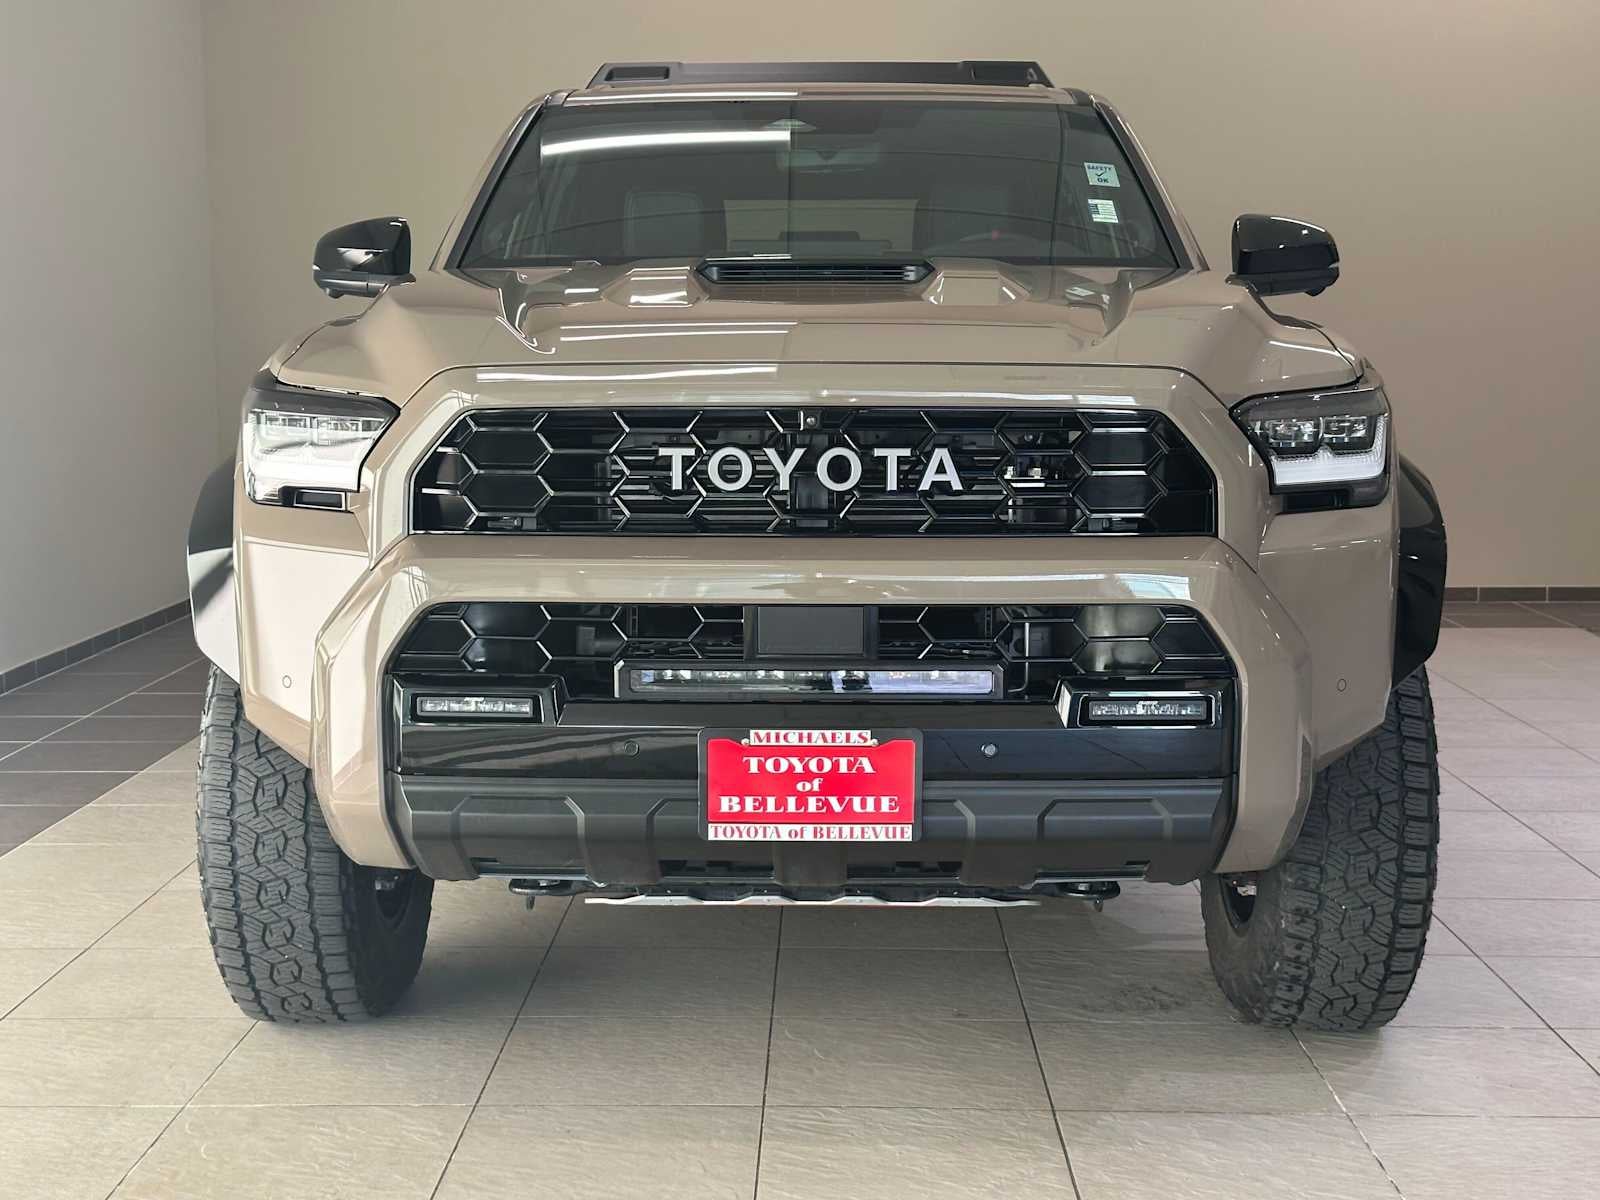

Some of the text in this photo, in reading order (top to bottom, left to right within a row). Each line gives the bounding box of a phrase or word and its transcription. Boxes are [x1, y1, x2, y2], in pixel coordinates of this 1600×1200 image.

[658, 447, 963, 491] TOYOTA
[753, 730, 869, 744] MICHAELS
[743, 756, 876, 774] TOYOTA
[796, 778, 823, 792] of
[719, 796, 900, 813] BELLEVUE
[710, 825, 911, 839] TOYOTA of BELLEVUE
